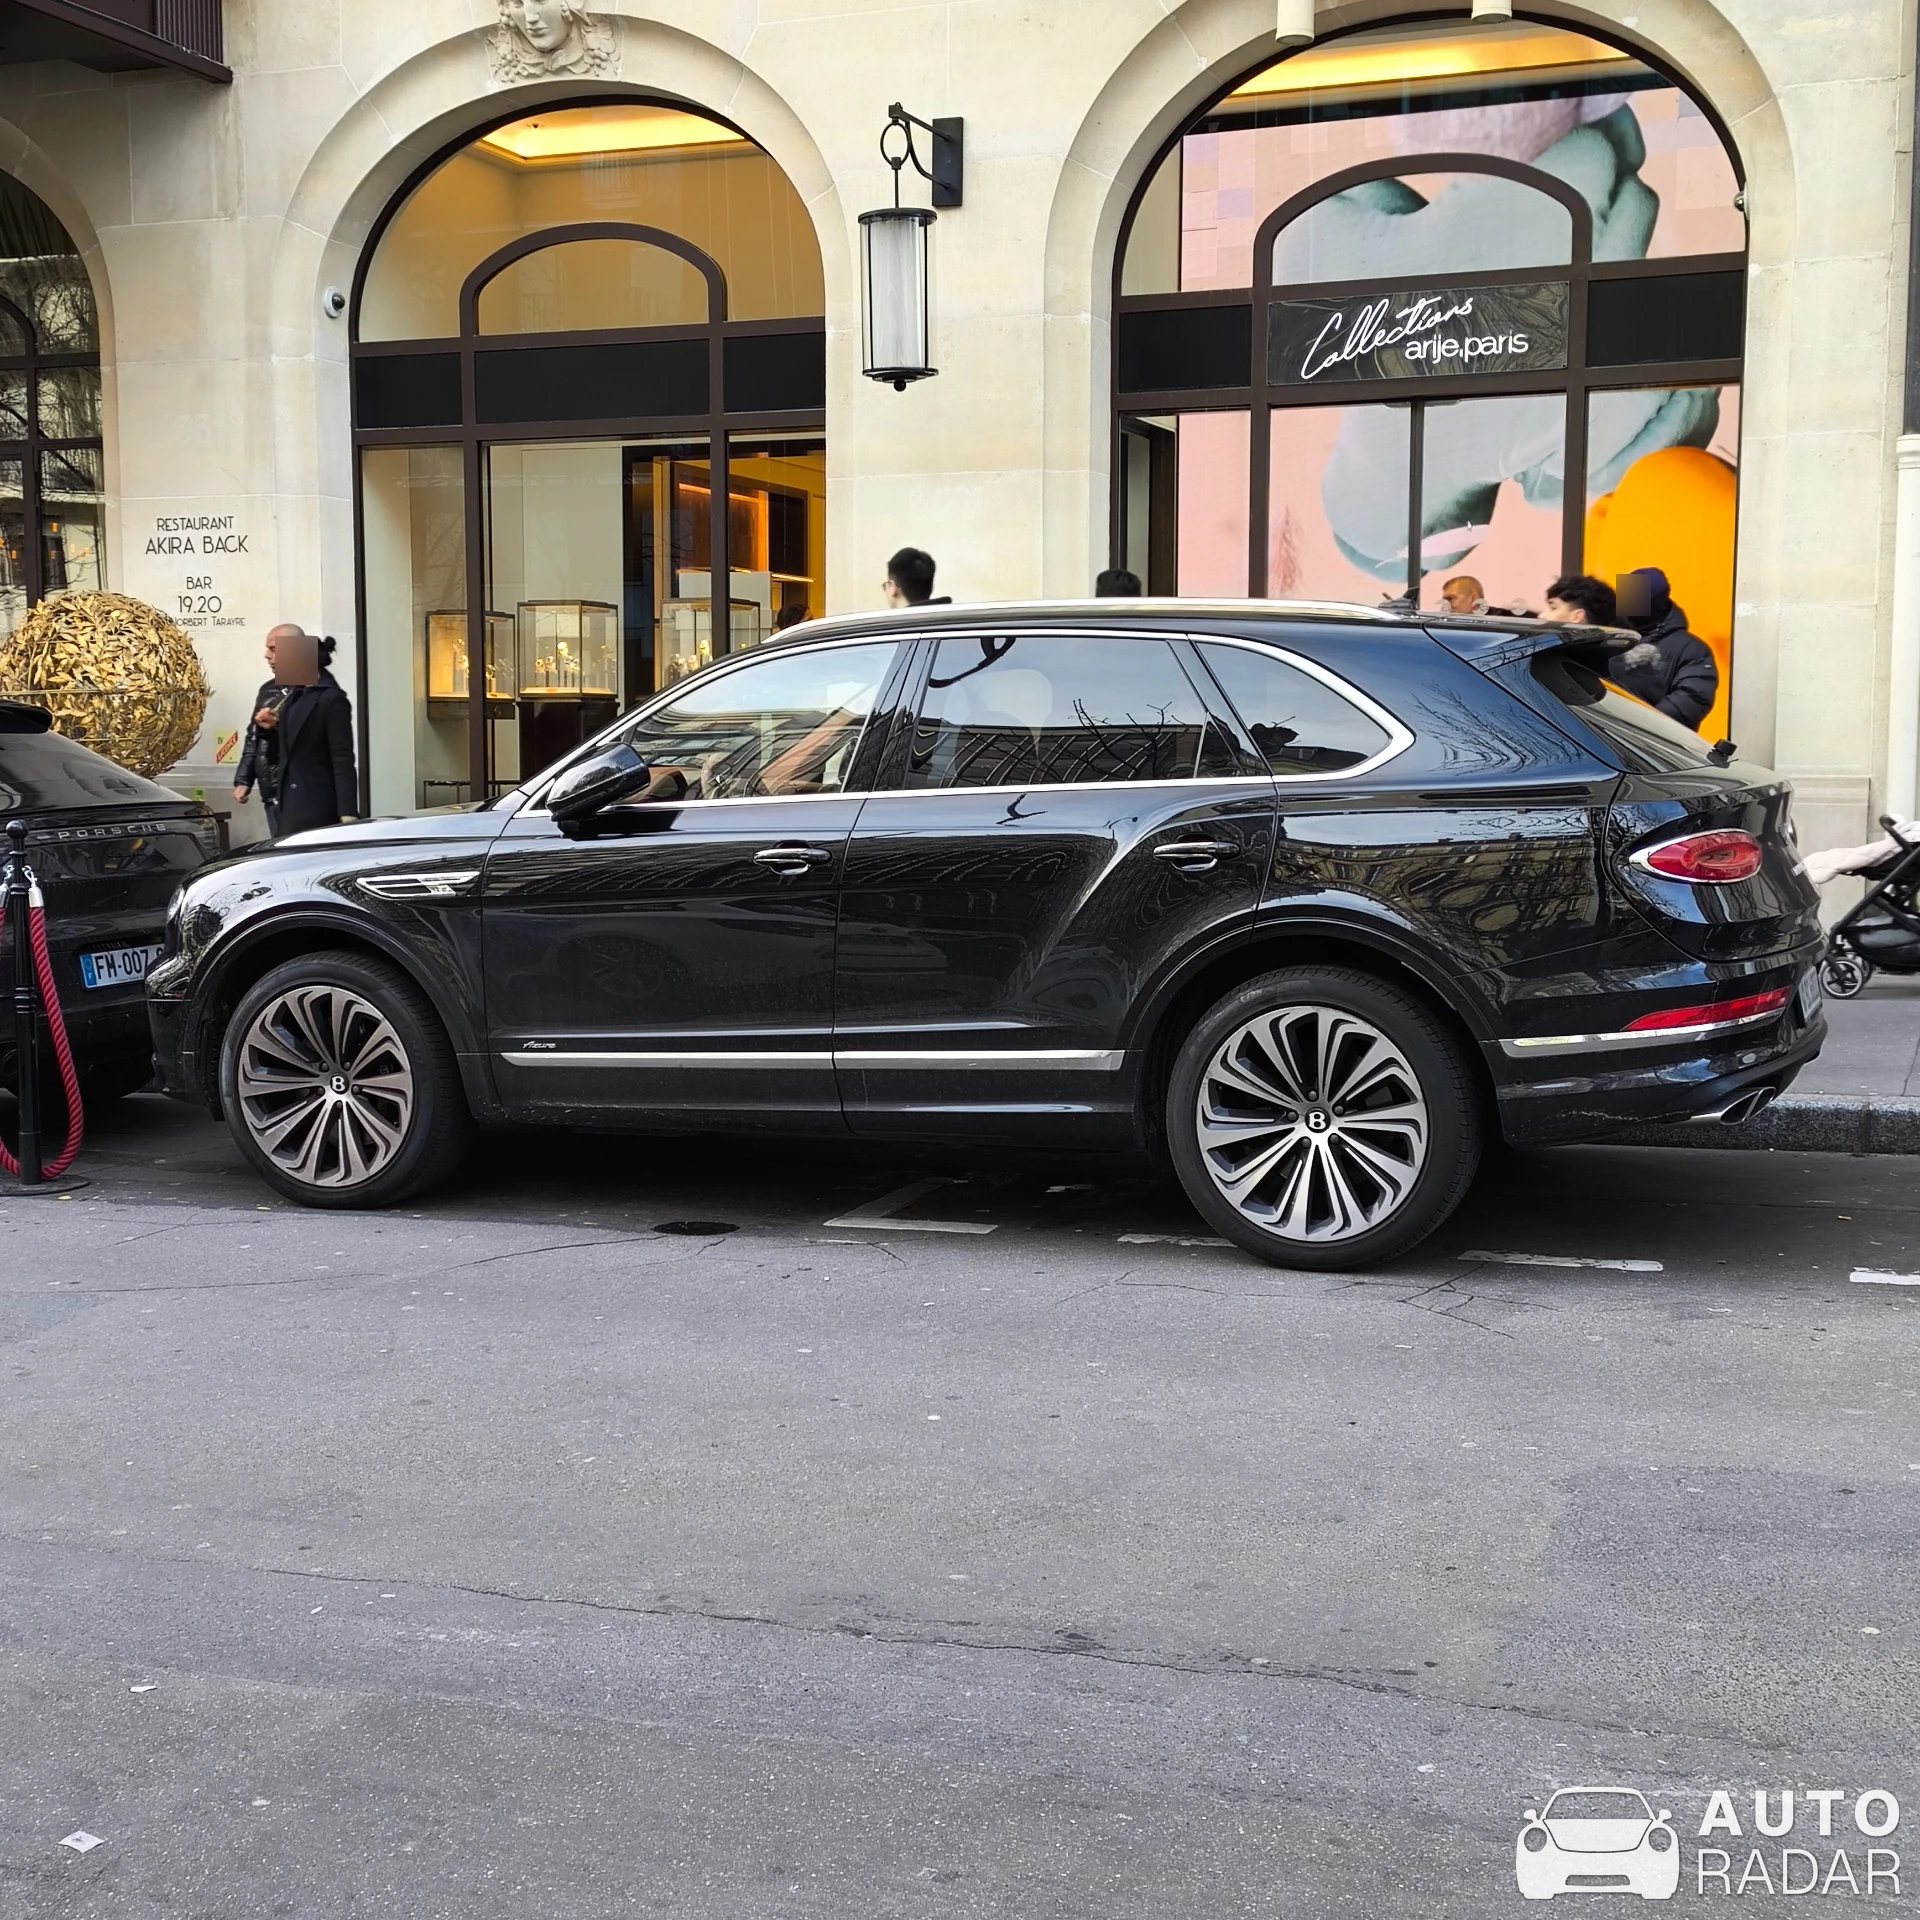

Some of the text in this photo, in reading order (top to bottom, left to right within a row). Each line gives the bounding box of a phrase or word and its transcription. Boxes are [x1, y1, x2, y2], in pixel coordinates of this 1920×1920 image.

[1300, 296, 1474, 380] Collections
[156, 515, 235, 532] RESTAURANT
[145, 534, 249, 555] AKIRA BACK
[186, 576, 213, 590] BAR
[177, 595, 222, 613] 19.20
[58, 823, 166, 839] PORSCHE
[331, 1075, 346, 1092] B
[1308, 1111, 1327, 1130] B
